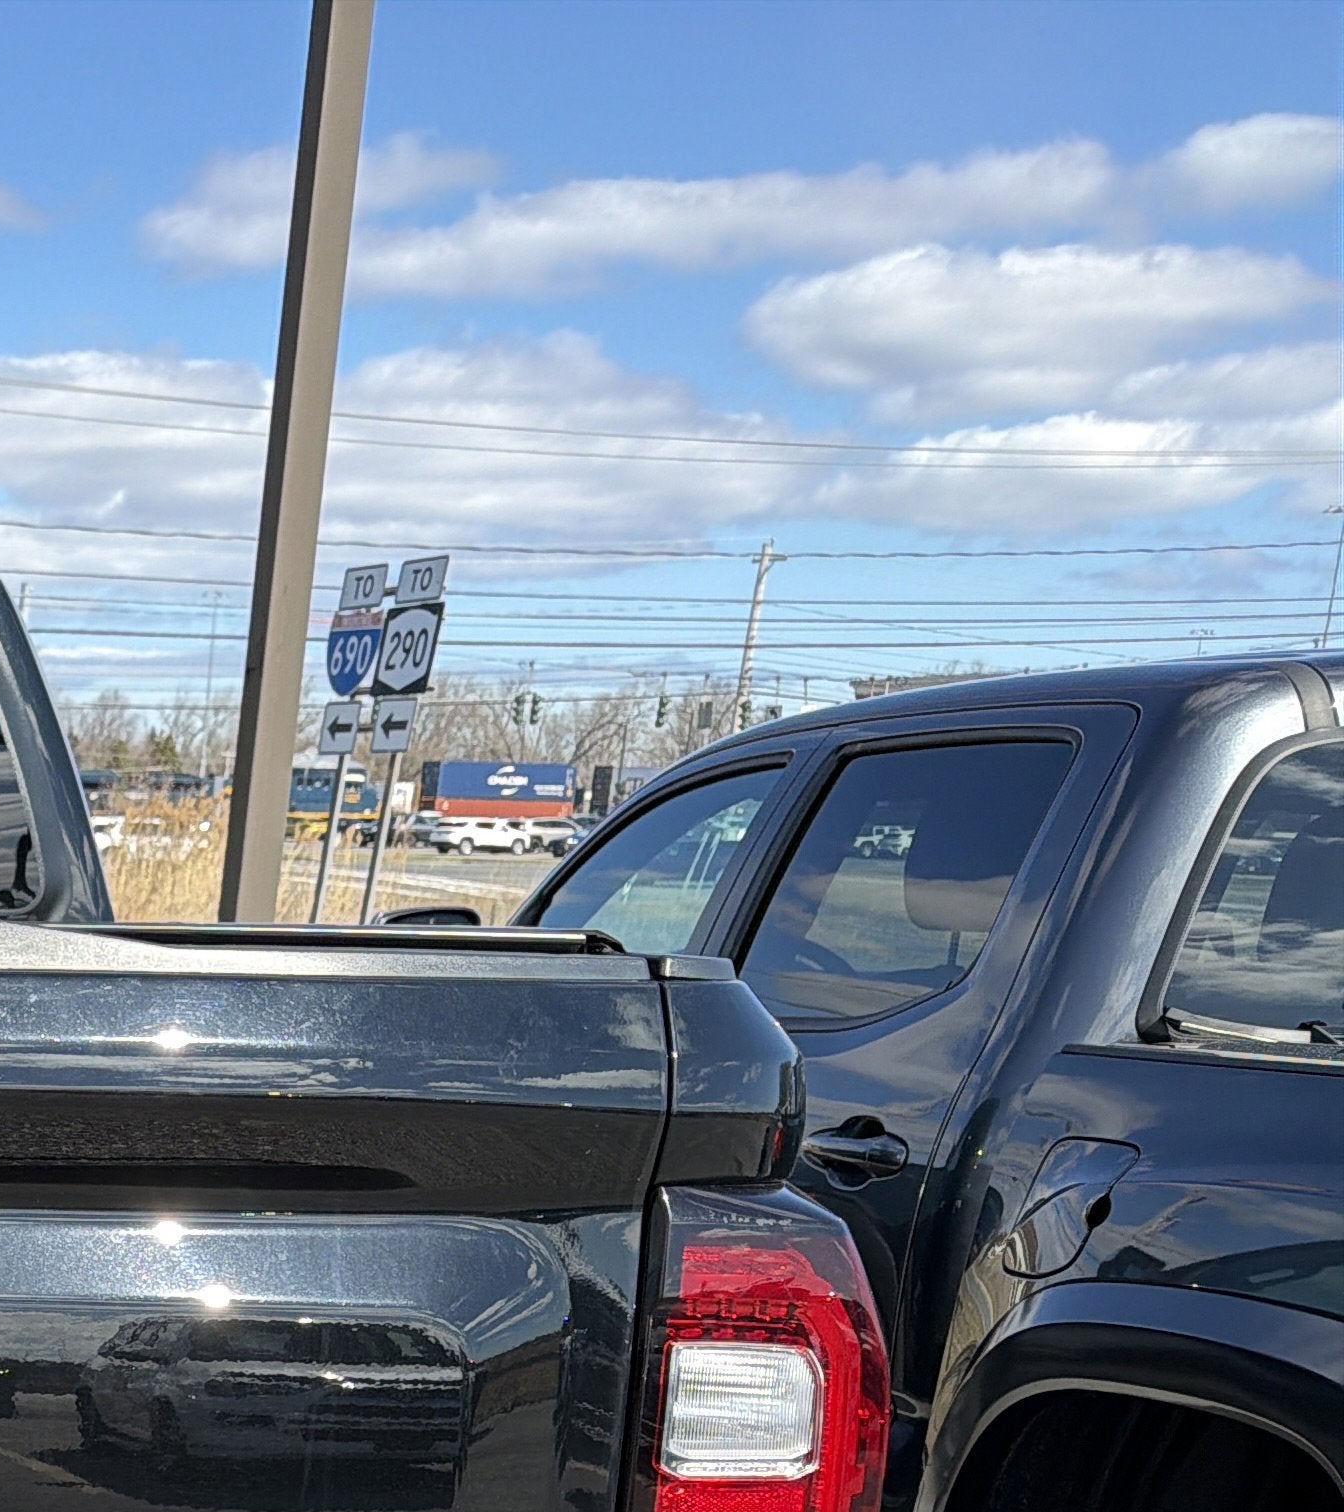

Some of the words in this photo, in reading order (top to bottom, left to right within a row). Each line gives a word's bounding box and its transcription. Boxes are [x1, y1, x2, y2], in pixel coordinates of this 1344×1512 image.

[354, 574, 375, 600] TO
[410, 566, 434, 593] TO
[330, 634, 372, 677] 690
[384, 627, 429, 672] 290
